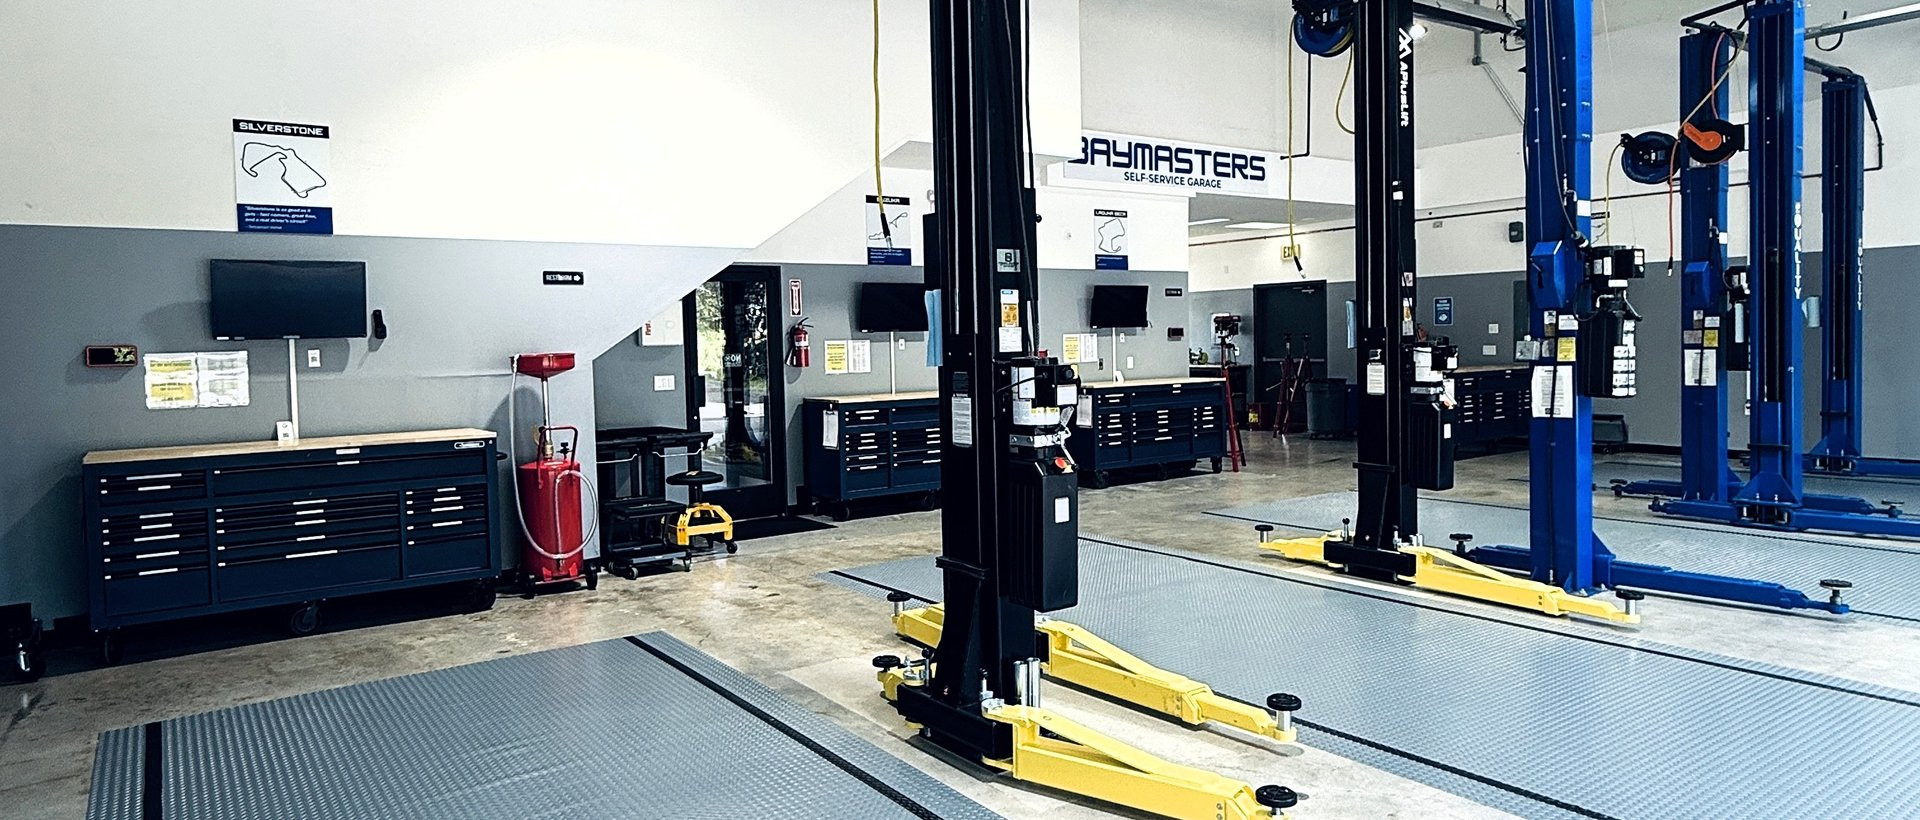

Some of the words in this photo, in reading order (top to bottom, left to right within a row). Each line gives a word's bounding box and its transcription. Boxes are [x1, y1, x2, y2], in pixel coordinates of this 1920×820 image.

[239, 121, 324, 136] SILVERSTONE
[1124, 171, 1186, 186] SELF-SERVICE
[1187, 177, 1222, 189] GARAGE
